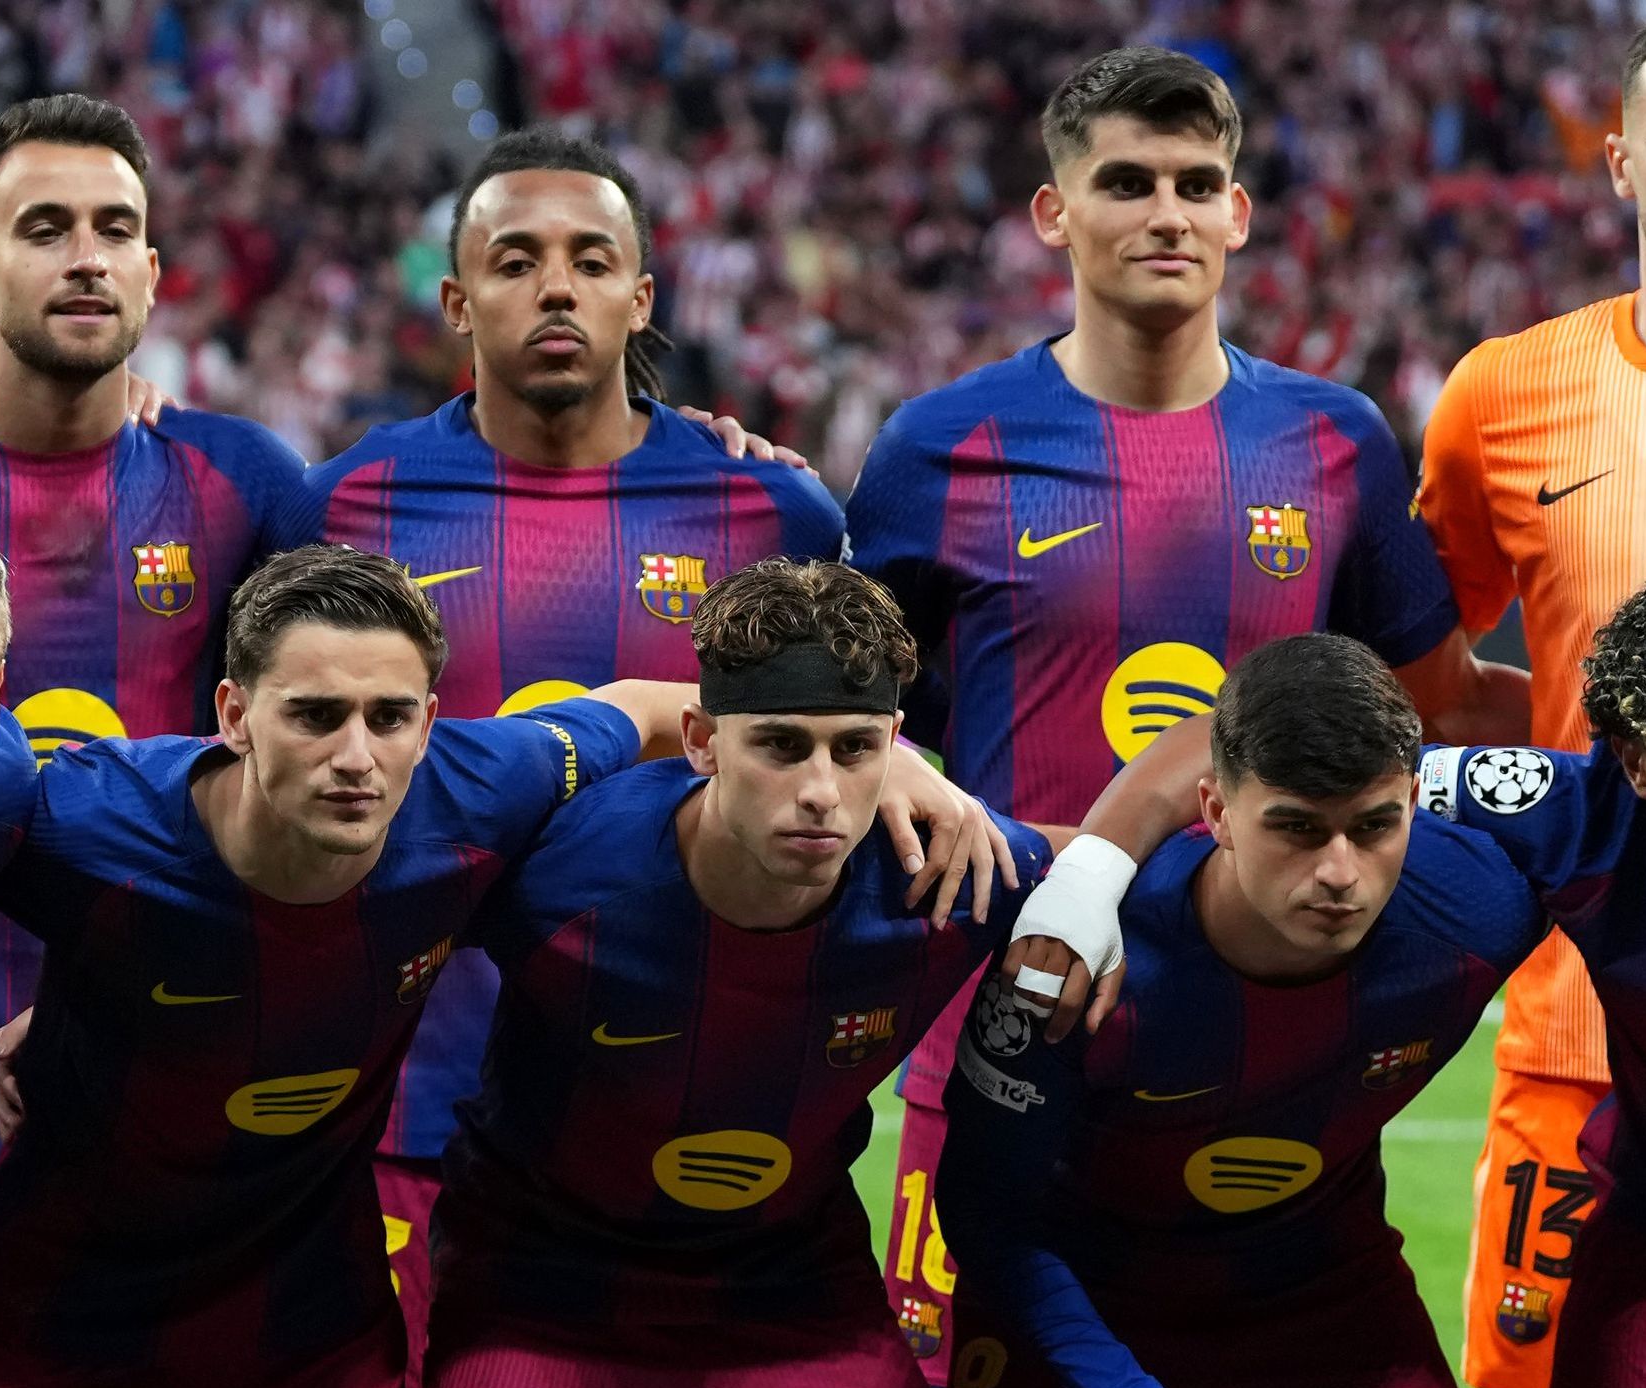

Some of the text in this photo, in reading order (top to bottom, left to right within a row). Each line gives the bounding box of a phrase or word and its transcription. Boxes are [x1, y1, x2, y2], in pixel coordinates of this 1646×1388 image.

[154, 573, 178, 582] FCB
[662, 581, 687, 591] FCB
[1503, 1159, 1598, 1280] 13
